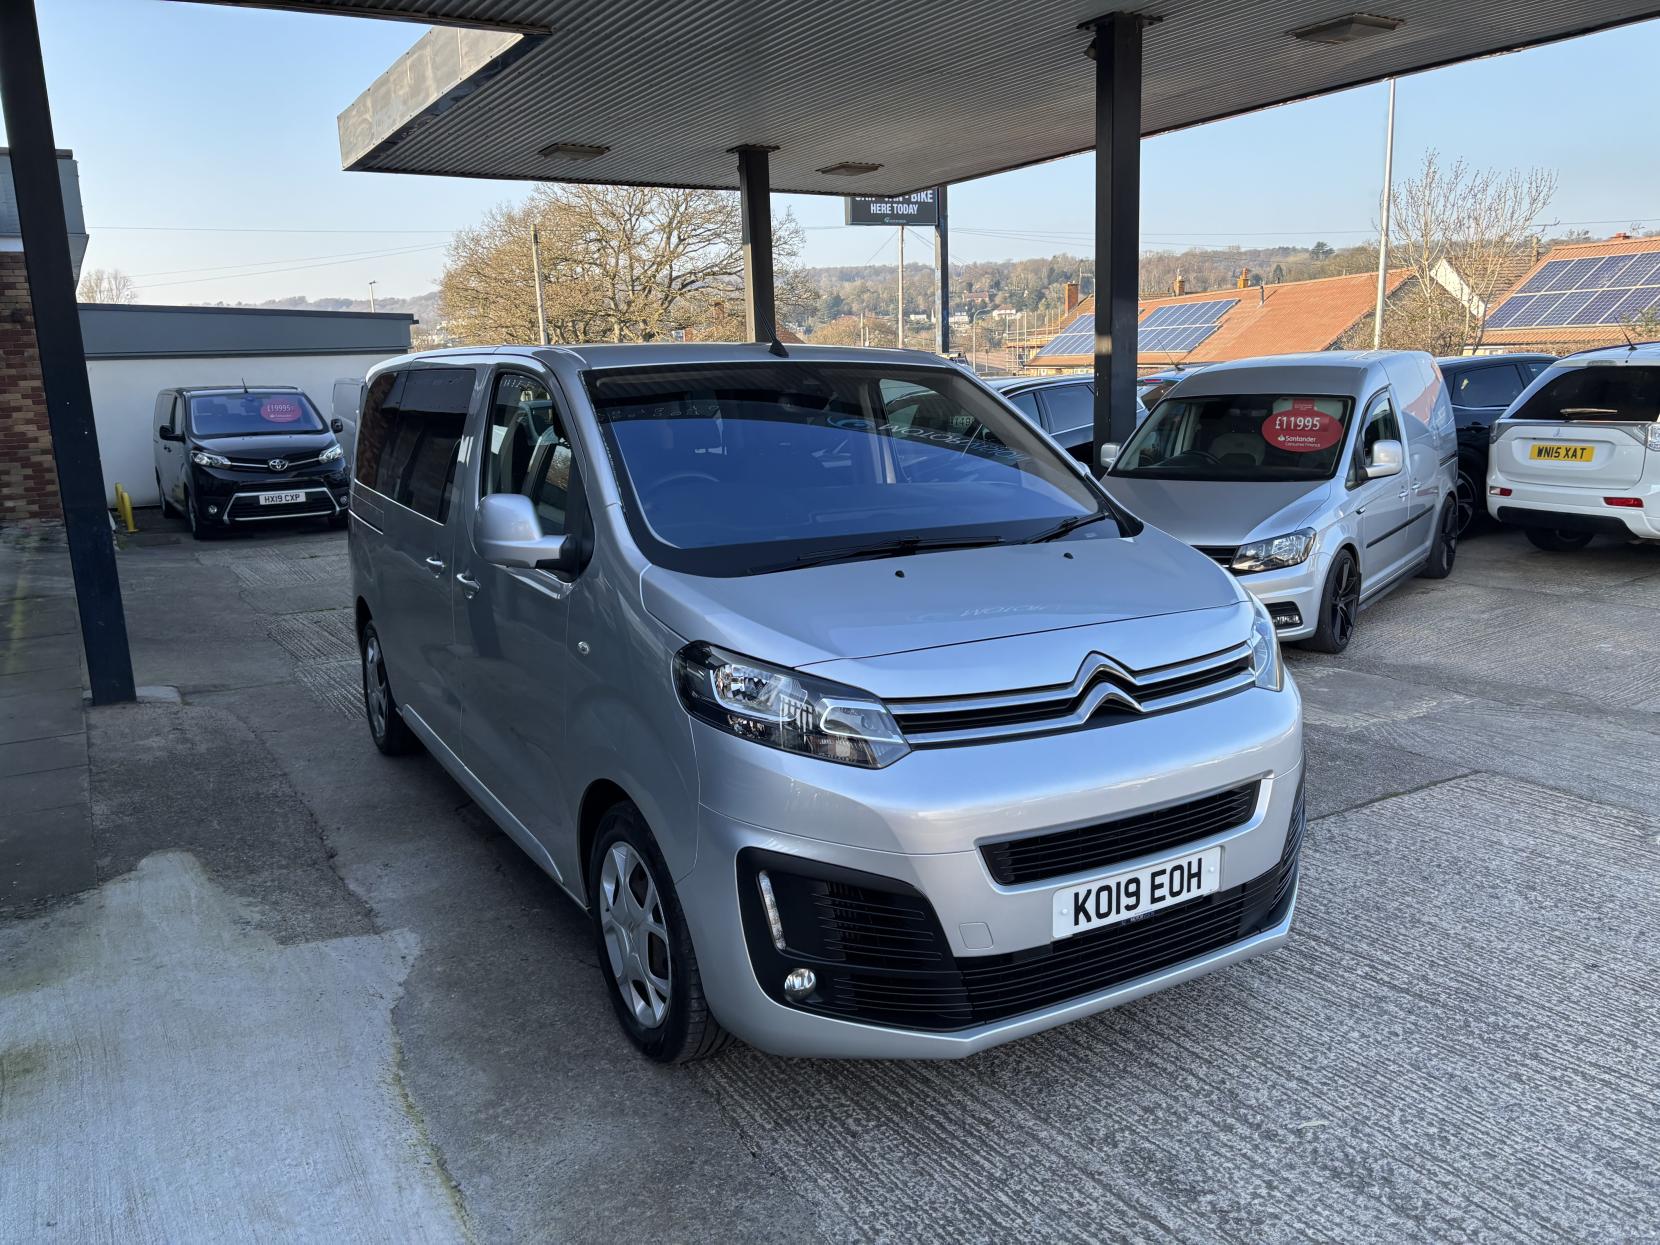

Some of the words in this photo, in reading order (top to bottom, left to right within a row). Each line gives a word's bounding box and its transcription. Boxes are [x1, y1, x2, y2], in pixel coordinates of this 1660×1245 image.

[911, 190, 933, 202] BIKE
[870, 203, 891, 214] HERE
[893, 203, 918, 214] TODAY
[1275, 416, 1320, 430] £11995
[1285, 435, 1316, 443] Santander
[1537, 447, 1562, 459] WN15
[1563, 447, 1586, 459] XAT
[264, 495, 283, 504] HX19
[285, 493, 300, 502] CXP
[1074, 877, 1141, 926] KO19
[1151, 858, 1202, 904] EOH
